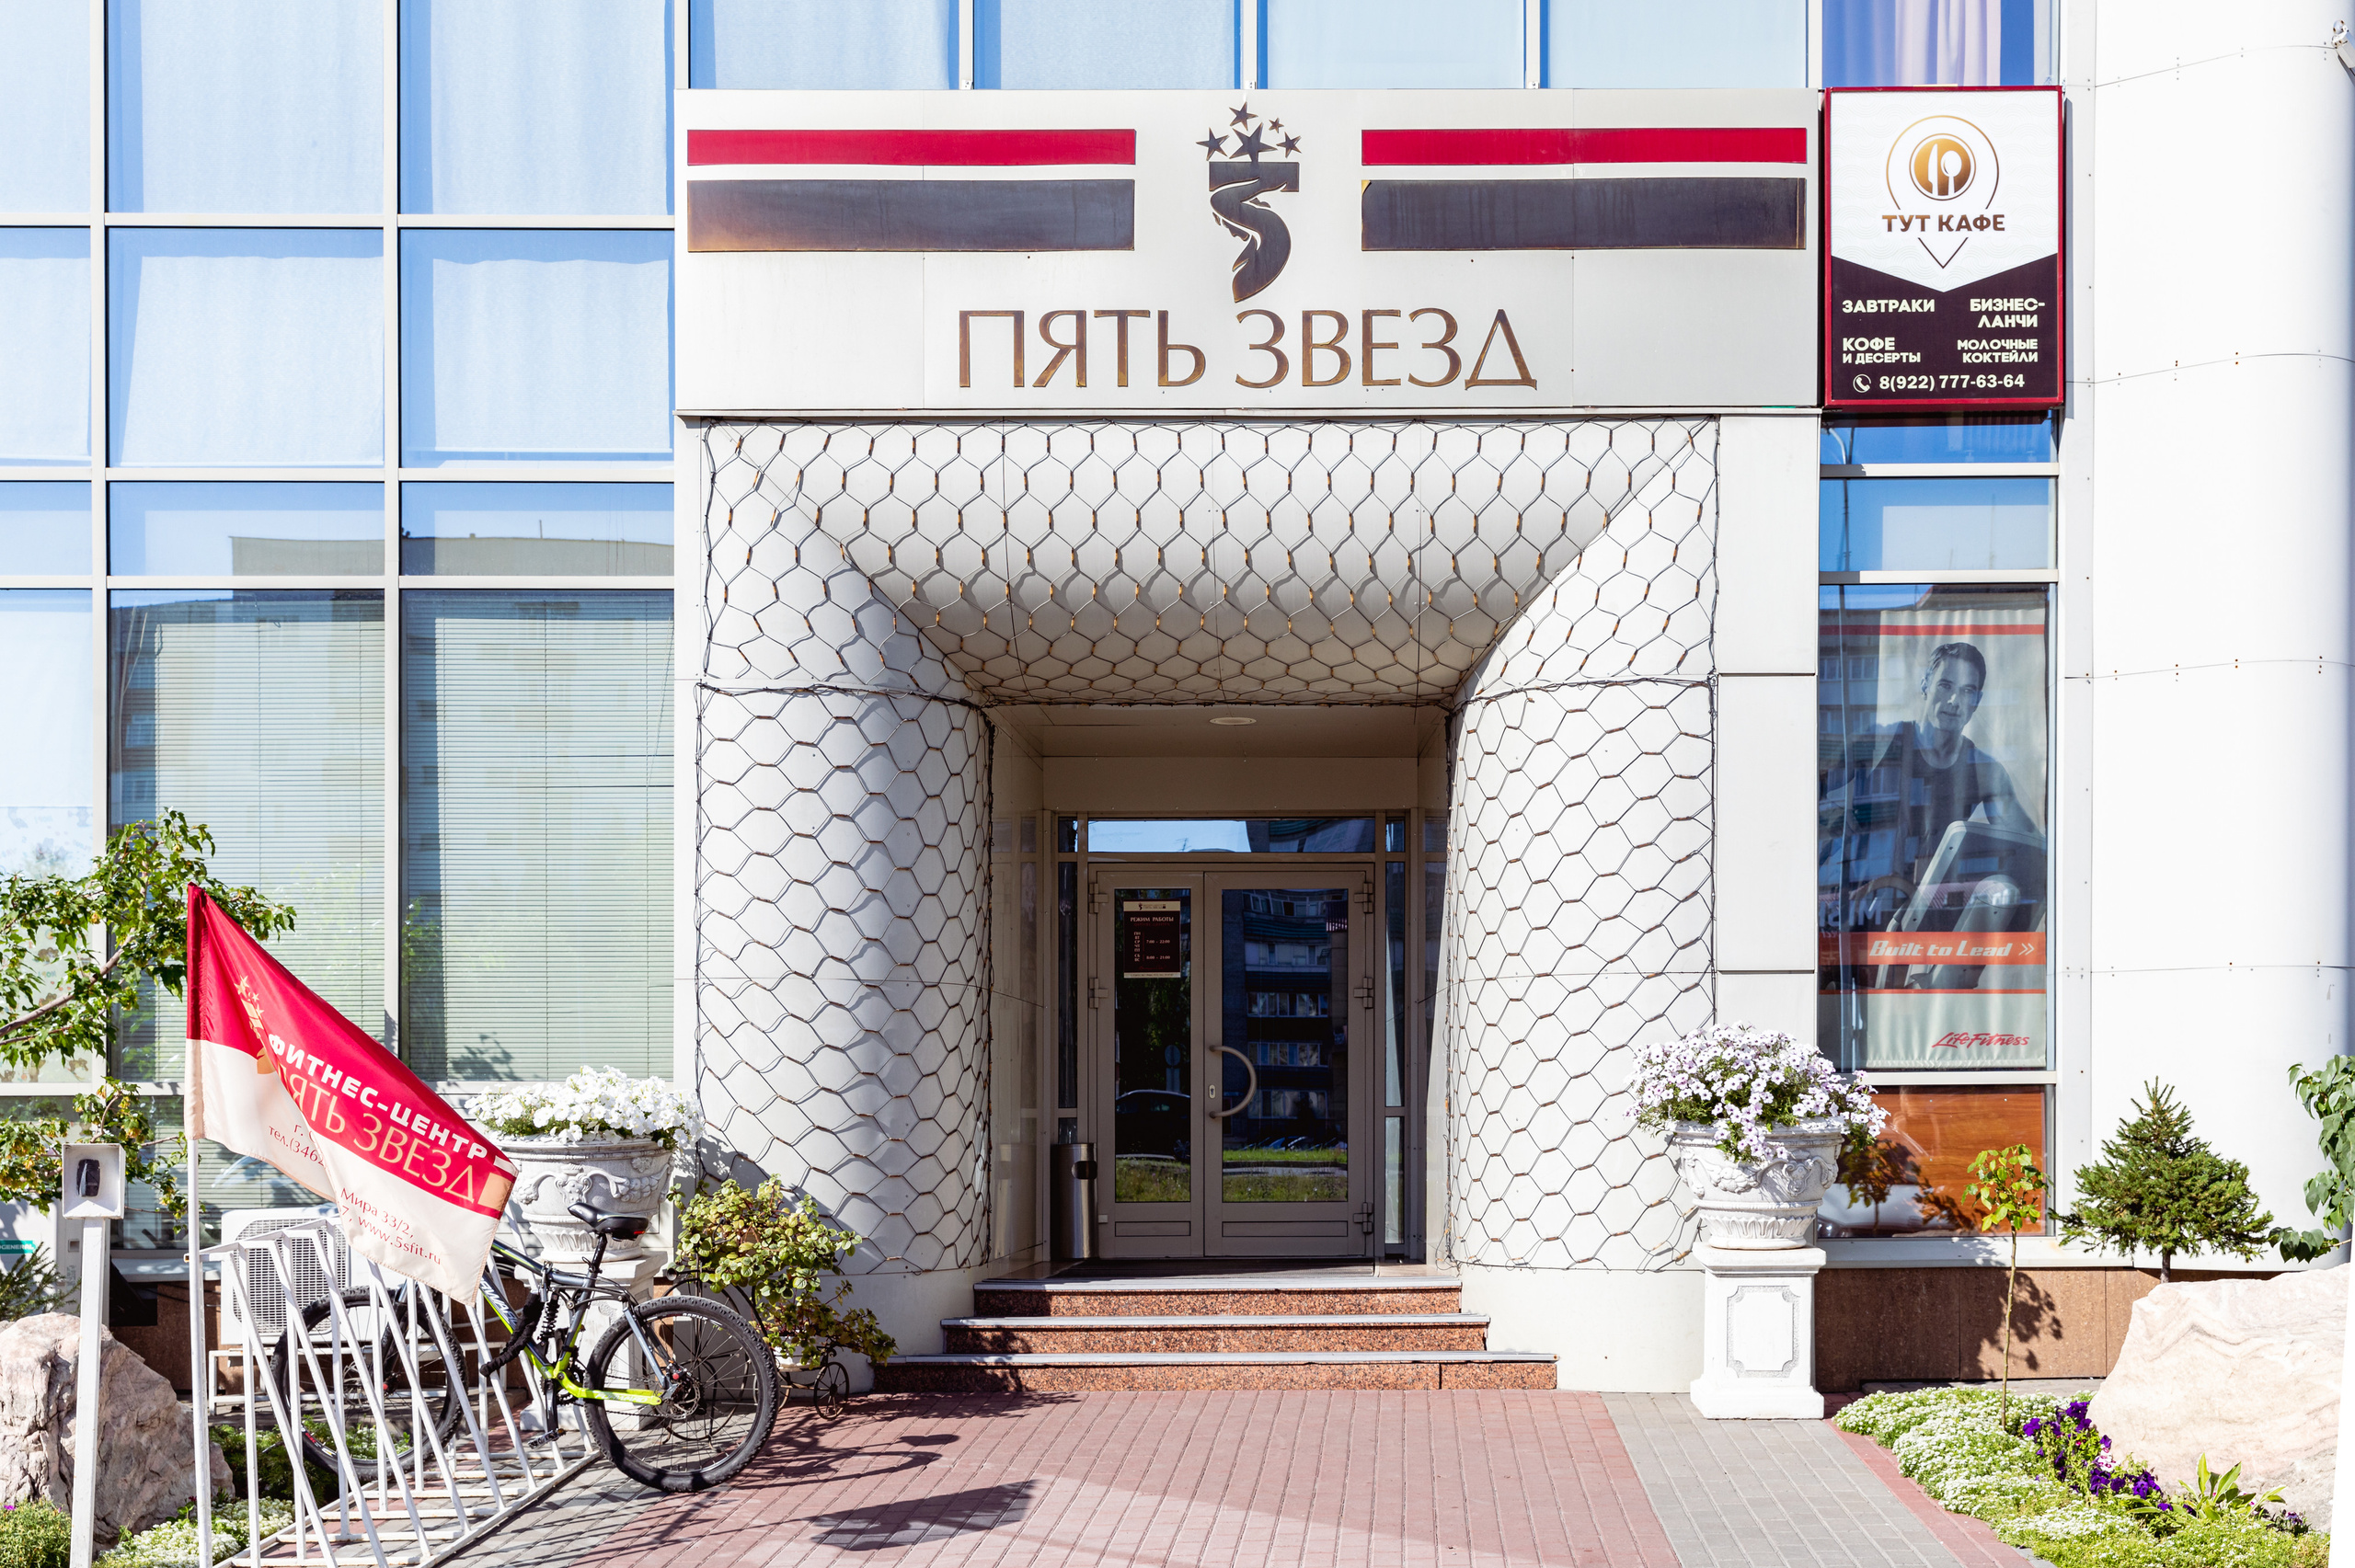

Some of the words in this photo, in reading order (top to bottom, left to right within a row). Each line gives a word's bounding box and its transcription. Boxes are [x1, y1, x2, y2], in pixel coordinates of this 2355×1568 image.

[1881, 214, 1931, 233] ТУТ
[1938, 213, 2005, 232] КАФЕ
[1842, 299, 1935, 313] ЗАВТРАКИ
[1970, 297, 2045, 313] БИЗНЕС-
[1978, 315, 2038, 328] ЛАНЧИ
[959, 309, 1206, 388] ПЯТЬ
[1235, 307, 1538, 391] ЗВЕЗД
[1843, 337, 1895, 351] КОФЕ
[1957, 338, 2038, 350] МОЛОЧНЫЕ
[1842, 352, 1852, 364] И
[1855, 352, 1921, 364] ДЕСЕРТЫ
[1962, 350, 2038, 363] КОКТЕЙЛИ
[1878, 374, 1936, 392] 8(922)
[1938, 372, 2025, 389] 777-63-64
[1869, 940, 1924, 956] Built
[1926, 943, 1953, 956] to
[1956, 940, 2013, 956] Lead
[268, 1032, 488, 1160] ФИТНЕС-ЦЕНТР
[354, 1113, 475, 1204] ЗВЕЗД
[340, 1187, 378, 1217] Мира
[381, 1210, 414, 1240] 33/2,
[358, 1216, 442, 1265] www.5sfit.ru
